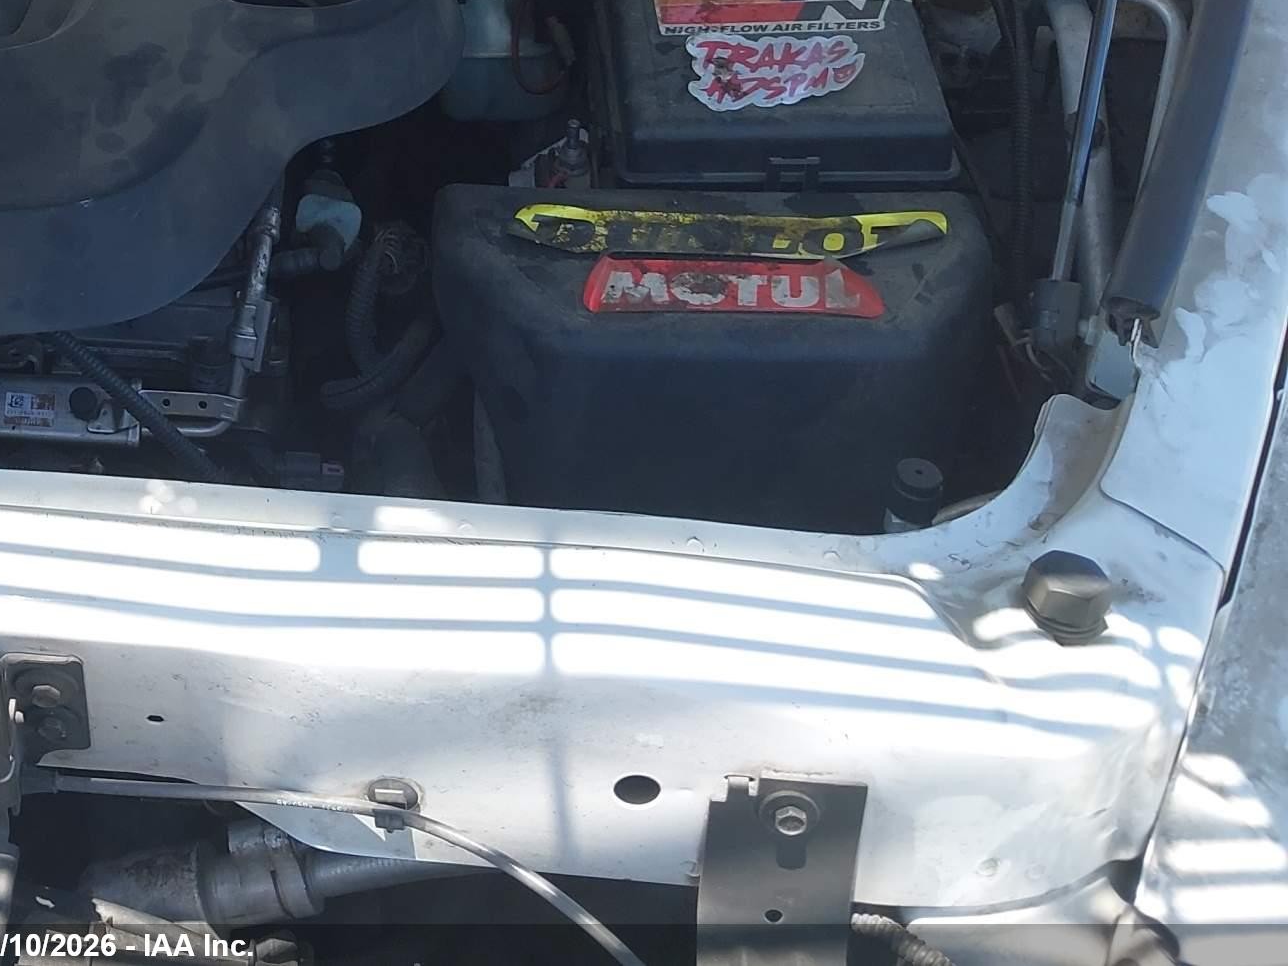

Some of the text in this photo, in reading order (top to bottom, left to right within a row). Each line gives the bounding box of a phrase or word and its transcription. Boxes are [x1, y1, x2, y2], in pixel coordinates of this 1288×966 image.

[772, 23, 803, 32] AIR
[807, 21, 880, 30] FILTERS
[600, 268, 861, 311] MOTUL
